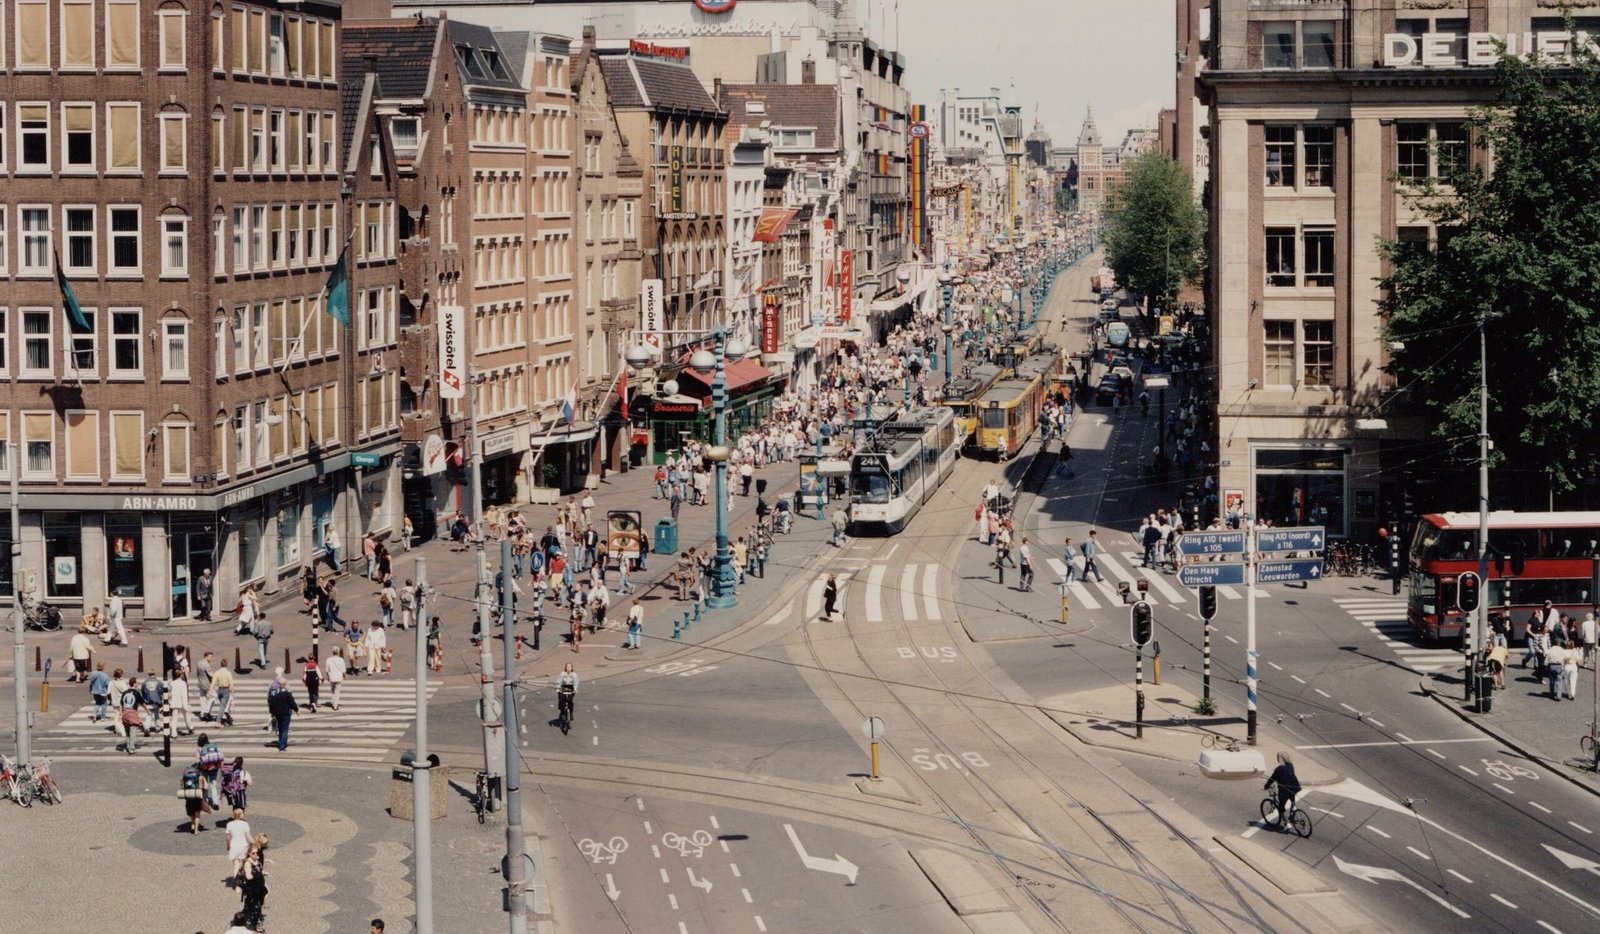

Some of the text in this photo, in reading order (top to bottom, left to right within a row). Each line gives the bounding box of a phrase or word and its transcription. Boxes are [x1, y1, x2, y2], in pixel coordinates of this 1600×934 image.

[1384, 32, 1456, 66] DE
[672, 147, 680, 211] HOTEL
[662, 212, 696, 220] AMSTERDAM
[824, 230, 833, 254] KFC
[647, 285, 656, 331] swissôtel
[824, 298, 833, 323] KFC
[445, 313, 456, 369] swissôtel
[655, 402, 695, 412] Brasserie
[355, 456, 374, 464] Change
[1184, 534, 1241, 546] Ring A10 (west)
[1260, 531, 1311, 542] Ring A10 (noord)
[1209, 544, 1222, 552] 105
[1283, 541, 1293, 549] 116
[1184, 567, 1219, 576] Den Haag
[1260, 564, 1293, 573] Zaanstad
[1184, 575, 1212, 584] Utrecht
[1260, 572, 1300, 581] Leeuwarden
[897, 646, 958, 658] BUS
[911, 751, 991, 771] BUS
